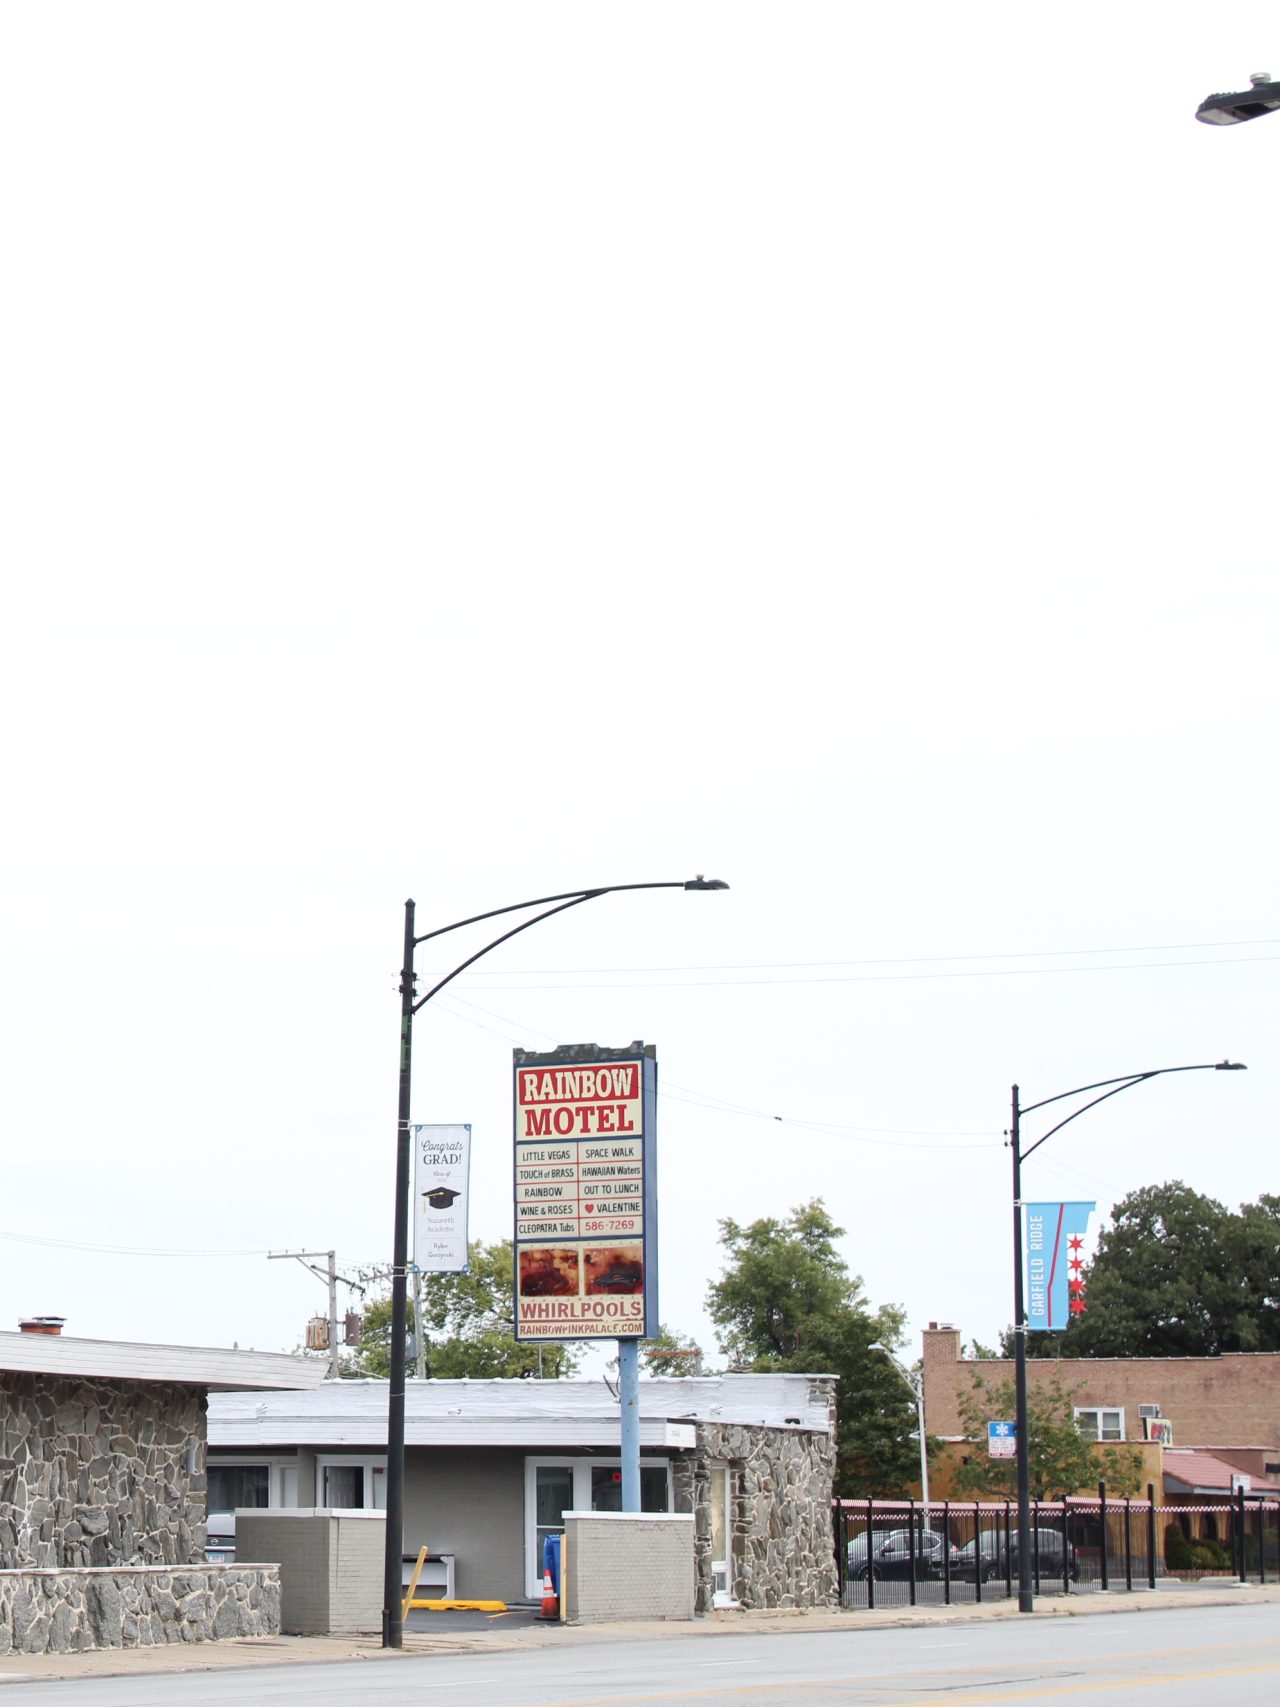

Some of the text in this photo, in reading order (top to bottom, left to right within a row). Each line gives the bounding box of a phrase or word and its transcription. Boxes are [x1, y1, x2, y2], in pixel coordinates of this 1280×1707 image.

[524, 1068, 633, 1101] RAINBOW
[525, 1104, 634, 1136] MOTEL
[421, 1140, 464, 1154] Congrats
[586, 1147, 634, 1158] SPACE WALK
[423, 1154, 462, 1165] GRAD!
[523, 1150, 570, 1162] LITTLE VEGAS
[520, 1170, 543, 1180] TOUCH
[551, 1168, 574, 1178] BRASS
[582, 1166, 640, 1176] HAWAIIAN Waters
[524, 1187, 563, 1197] RAINBOW
[584, 1184, 639, 1195] OUT TO LUNCH
[520, 1206, 539, 1216] WINE
[548, 1205, 573, 1214] ROSES
[596, 1202, 640, 1212] VALENTINE
[519, 1223, 574, 1234] CLEOPATRA Tubs
[585, 1220, 634, 1231] 586-7269
[1030, 1216, 1044, 1316] GARFIELD RIDGE
[521, 1301, 642, 1318] WHIRLPOOLS
